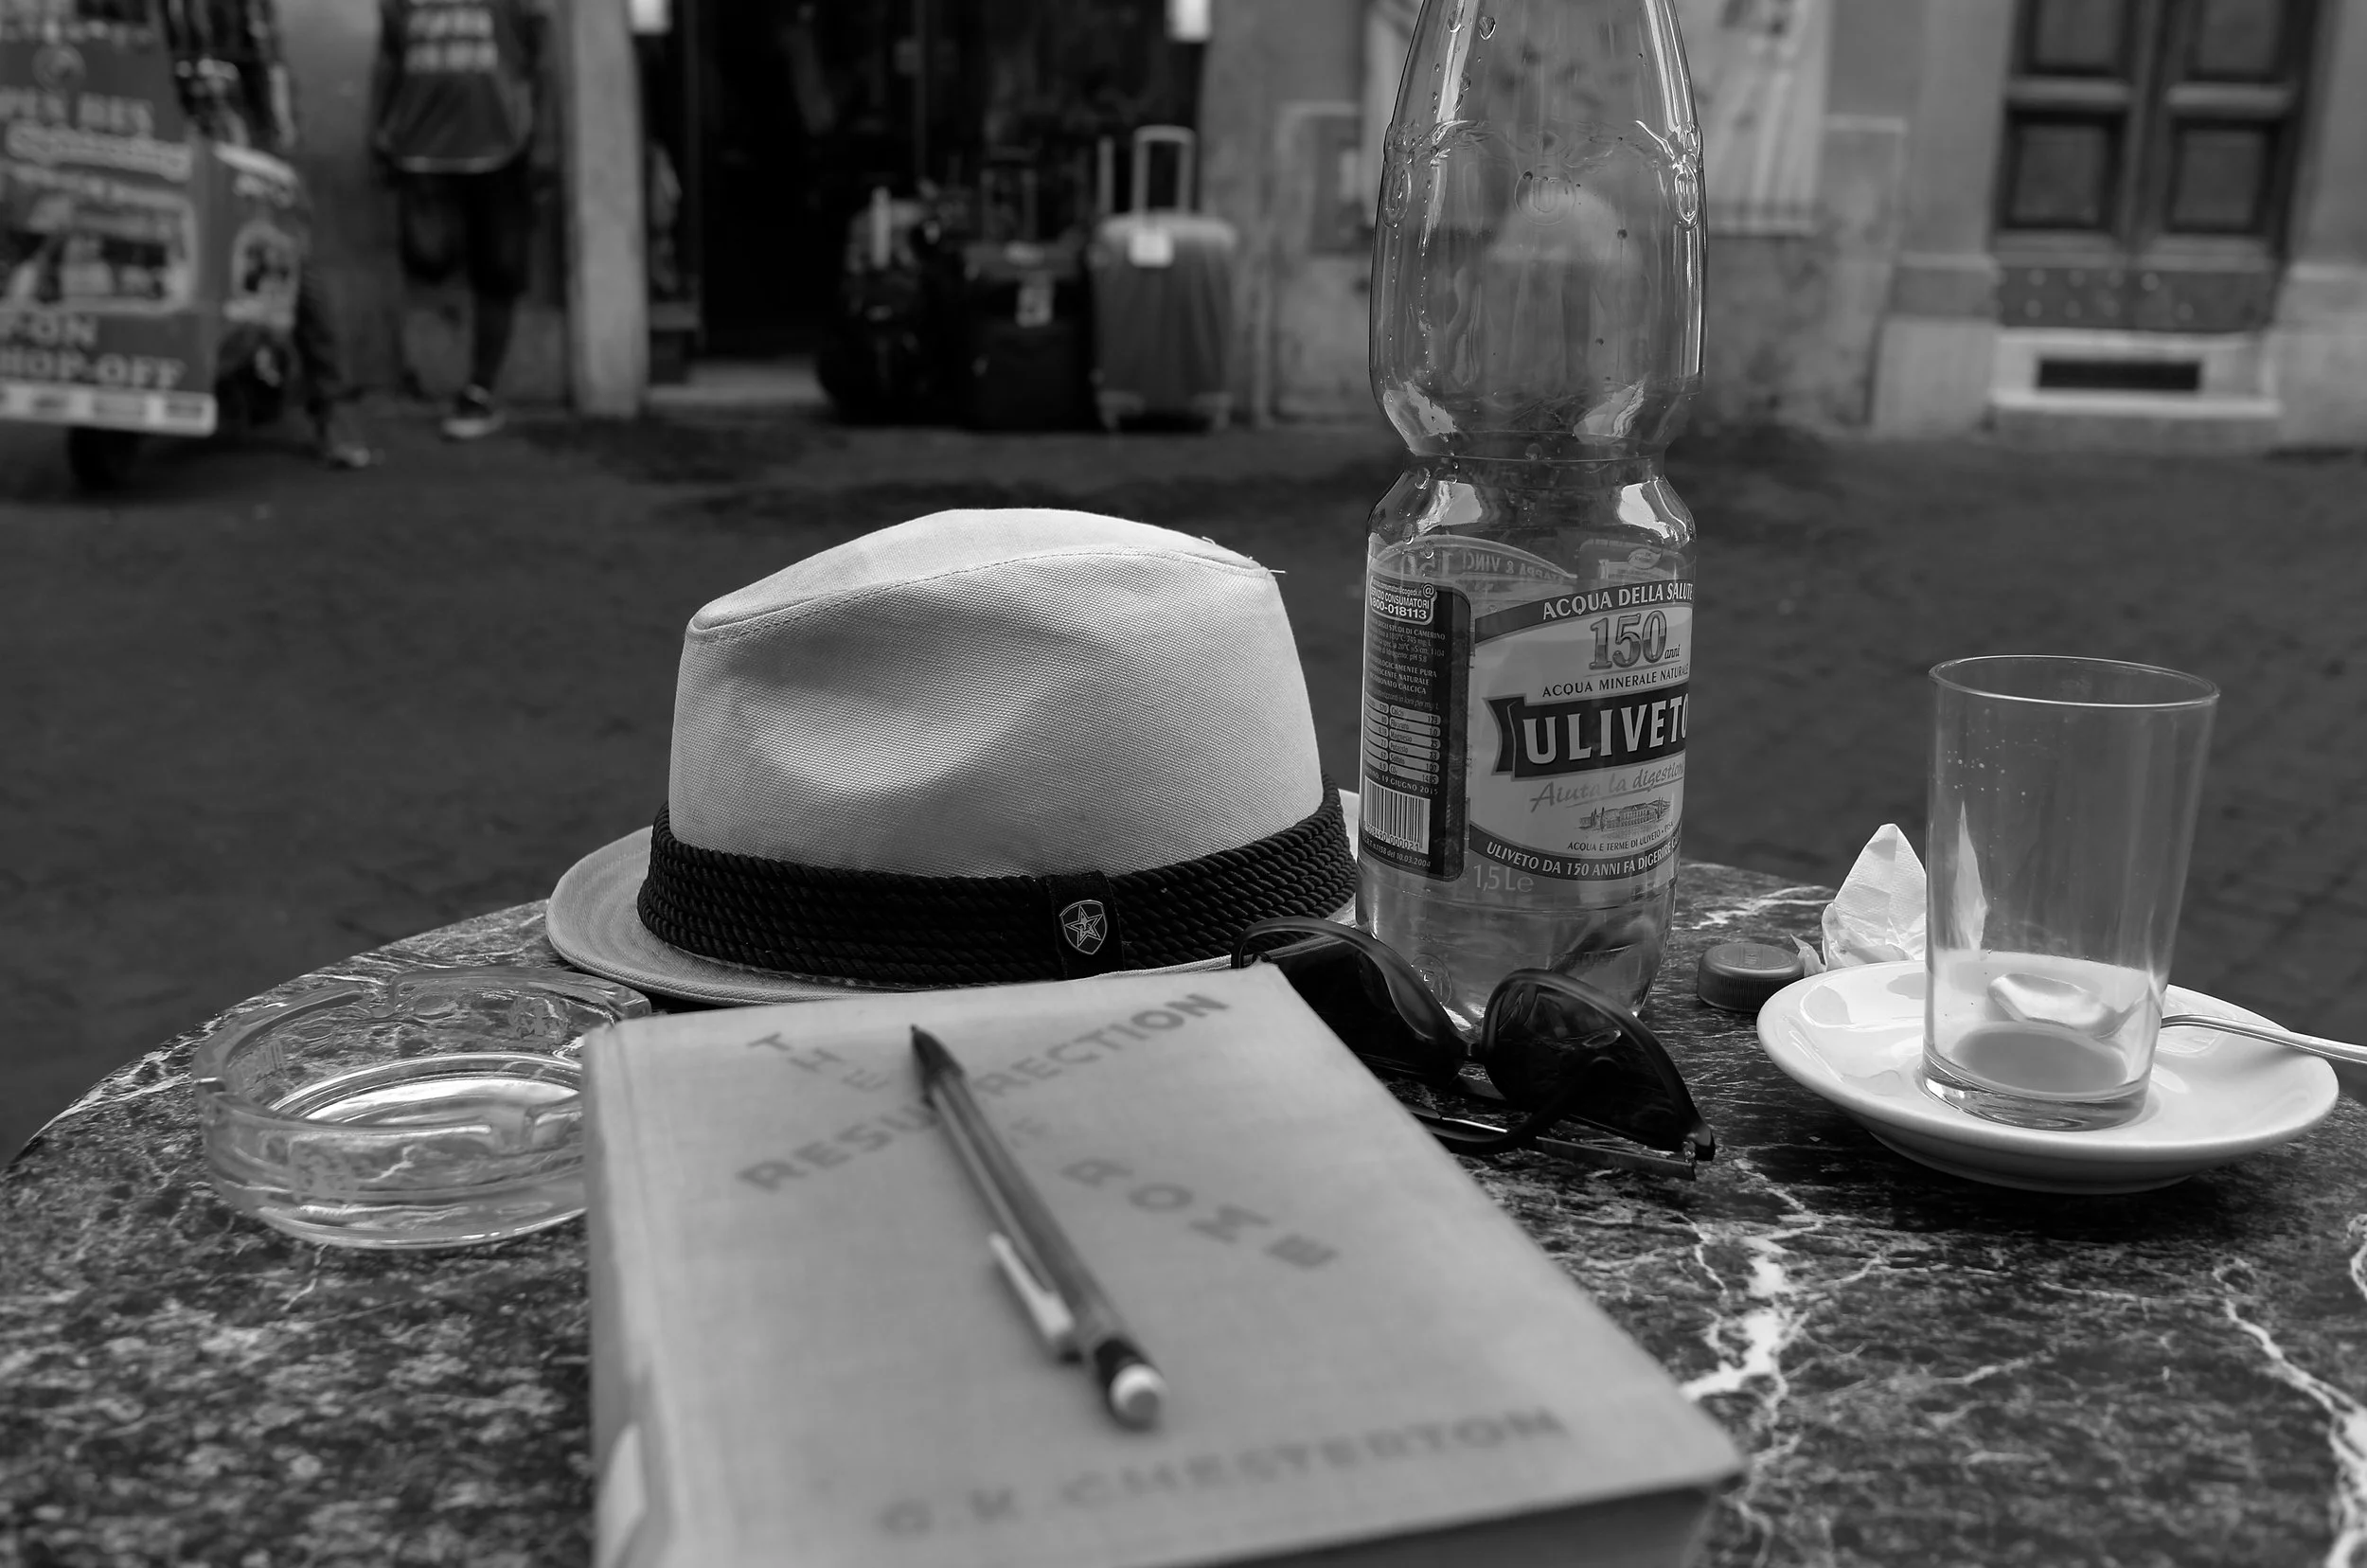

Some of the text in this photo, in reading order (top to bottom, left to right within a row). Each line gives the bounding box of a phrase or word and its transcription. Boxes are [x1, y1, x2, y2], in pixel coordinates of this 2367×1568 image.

[1372, 597, 1427, 619] 800-018113
[1385, 592, 1430, 610] CONSUMATORI
[1542, 591, 1612, 620] ACQUA
[1618, 583, 1664, 606] DELLA
[1414, 629, 1446, 640] CAMERINO
[1589, 610, 1681, 670] 150 anni
[1398, 673, 1430, 686] NATURALE
[1419, 668, 1437, 678] PURA
[1542, 681, 1593, 698] ACQUA
[1598, 670, 1657, 691] MINERALE
[1398, 683, 1427, 695] CALCICA
[1522, 693, 1688, 765] ULIVETO
[1390, 777, 1417, 792] GIUGNO
[1530, 781, 1601, 813] Aiuta
[1609, 773, 1628, 793] la
[1567, 841, 1597, 852] ACQUA
[1599, 843, 1605, 851] E
[1606, 841, 1629, 851] TERME
[1630, 839, 1638, 848] DI
[1639, 829, 1662, 846] ULIVETO
[1486, 841, 1671, 877] ULIVETO DA 150 ANNI FA DIGERIRE
[747, 1031, 891, 1095] THE
[737, 990, 1232, 1193] RESURECTION
[1059, 1155, 1341, 1271] ROME
